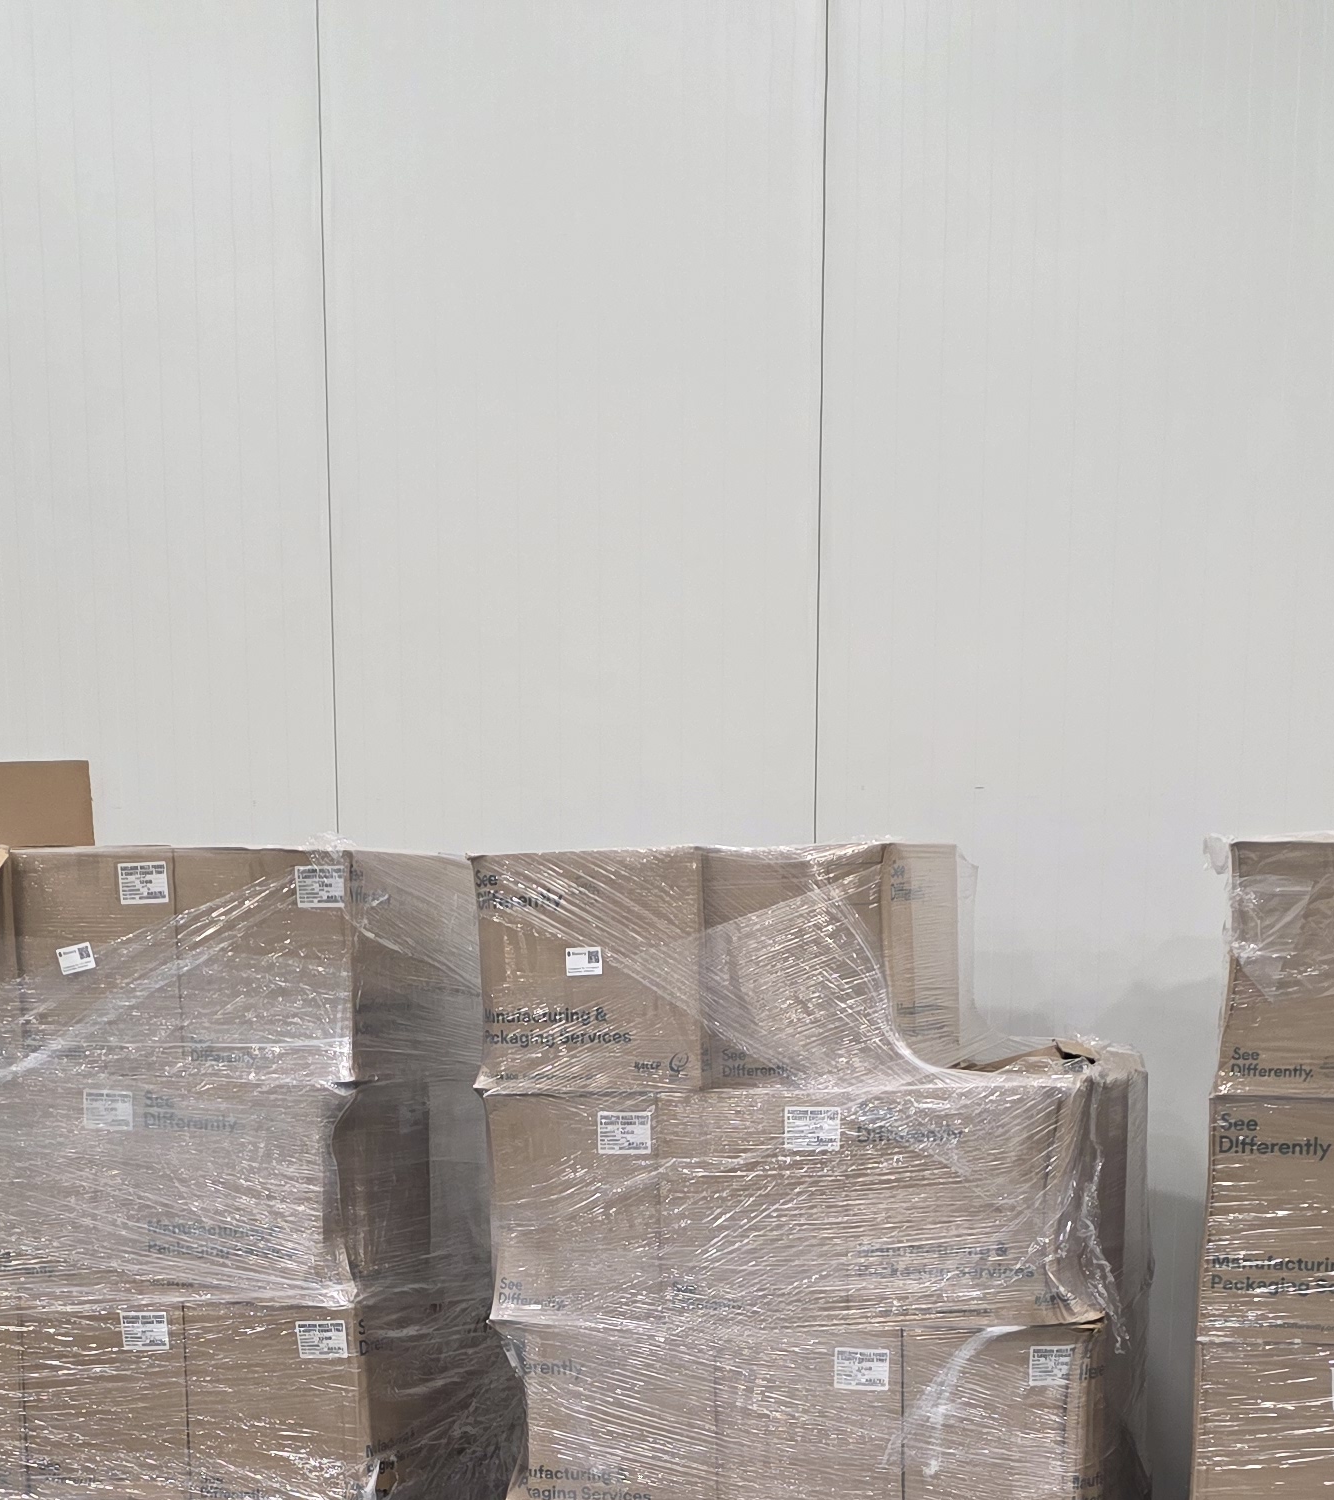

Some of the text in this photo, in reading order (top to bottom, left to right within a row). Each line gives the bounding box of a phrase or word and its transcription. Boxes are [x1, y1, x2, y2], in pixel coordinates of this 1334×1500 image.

[476, 870, 497, 887] See
[595, 1006, 607, 1023] &
[559, 1030, 632, 1045] Services
[722, 1050, 746, 1062] See
[1231, 1047, 1259, 1061] See
[1220, 1113, 1258, 1132] See
[500, 1277, 522, 1290] See
[1210, 1274, 1310, 1296] Packaging
